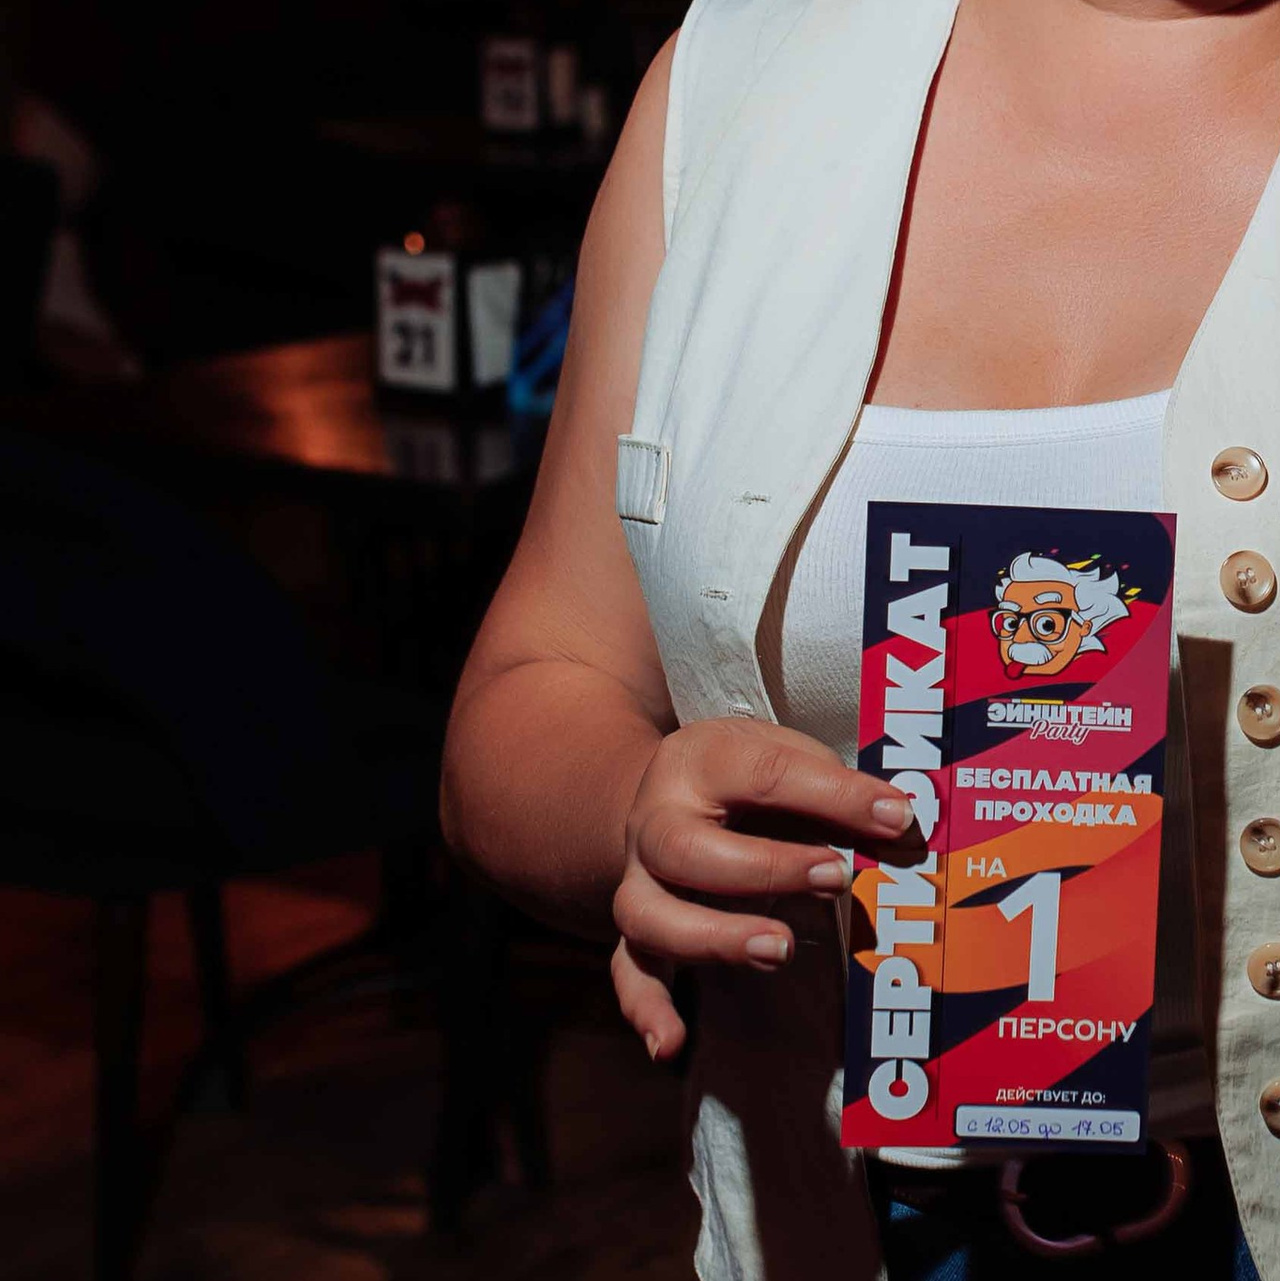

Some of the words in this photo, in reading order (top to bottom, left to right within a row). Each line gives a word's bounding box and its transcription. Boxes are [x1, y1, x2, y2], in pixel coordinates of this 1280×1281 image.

[987, 699, 1133, 727] ЭЙНШТЕЙН
[1029, 718, 1090, 746] Party
[956, 767, 1153, 795] БЕСПЛАТНАЯ
[974, 800, 1138, 827] ПРОХОДКА
[966, 856, 1008, 878] НА
[997, 872, 1062, 1001] 1
[998, 1017, 1137, 1043] ПЕРСОНУ
[995, 1086, 1079, 1102] ДЕЙСТВУЕТ
[1081, 1091, 1106, 1105] ДО:
[984, 1116, 1032, 1135] 12.05
